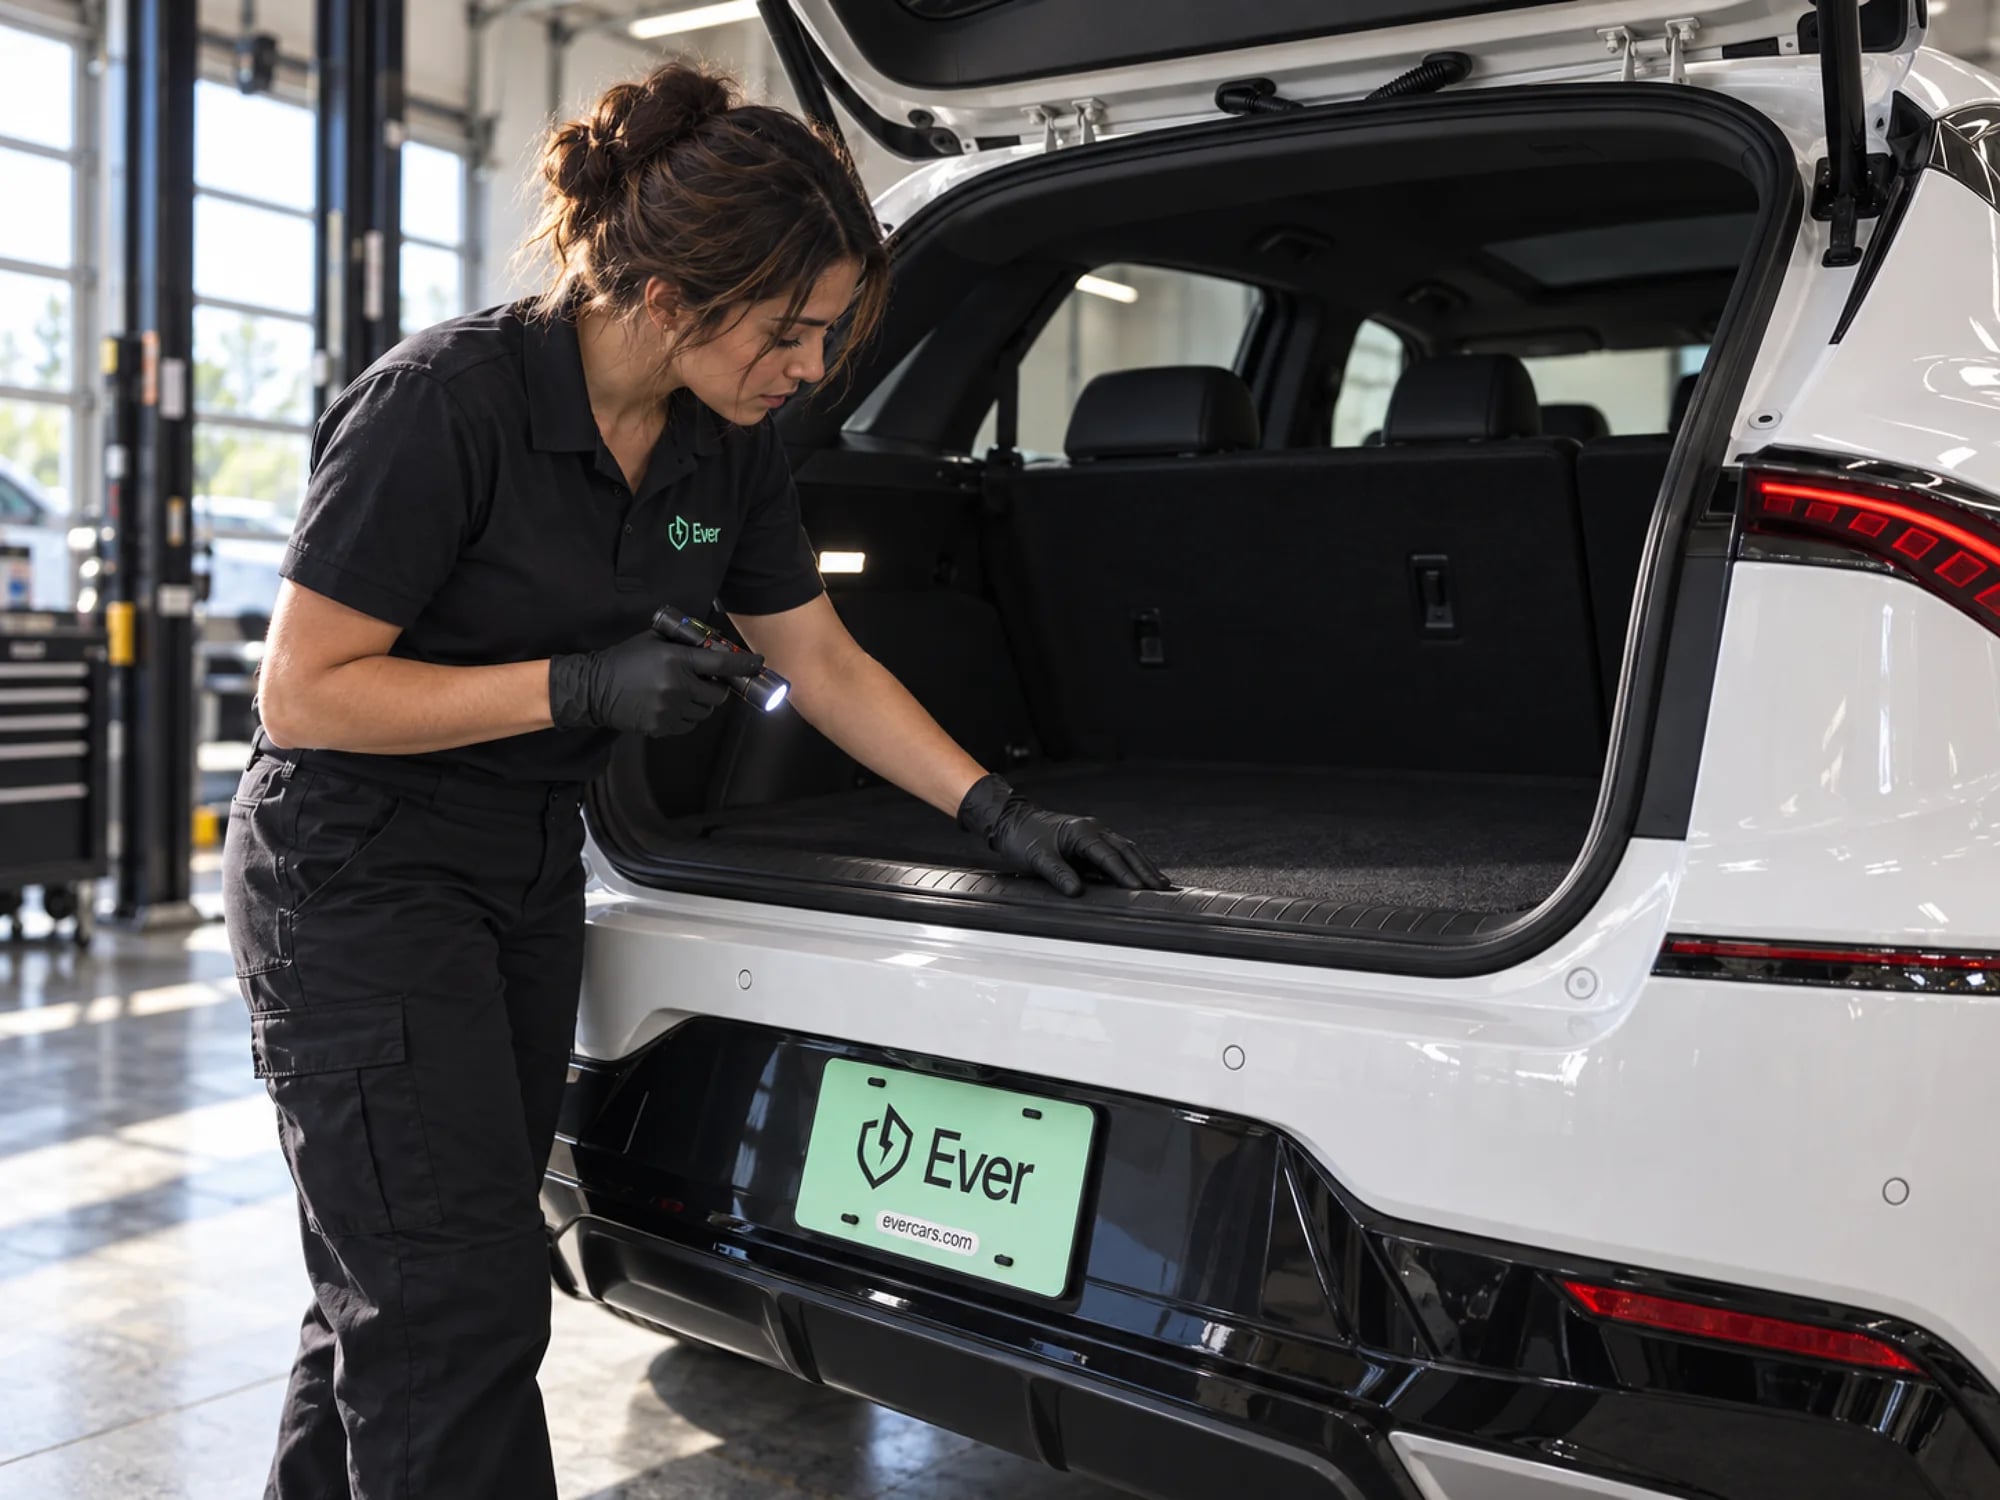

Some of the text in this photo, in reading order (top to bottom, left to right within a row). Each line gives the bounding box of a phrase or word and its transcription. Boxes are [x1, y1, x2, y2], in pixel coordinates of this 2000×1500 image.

[692, 522, 721, 544] Ever
[923, 1127, 1035, 1205] Ever
[882, 1213, 972, 1251] evercars.com
